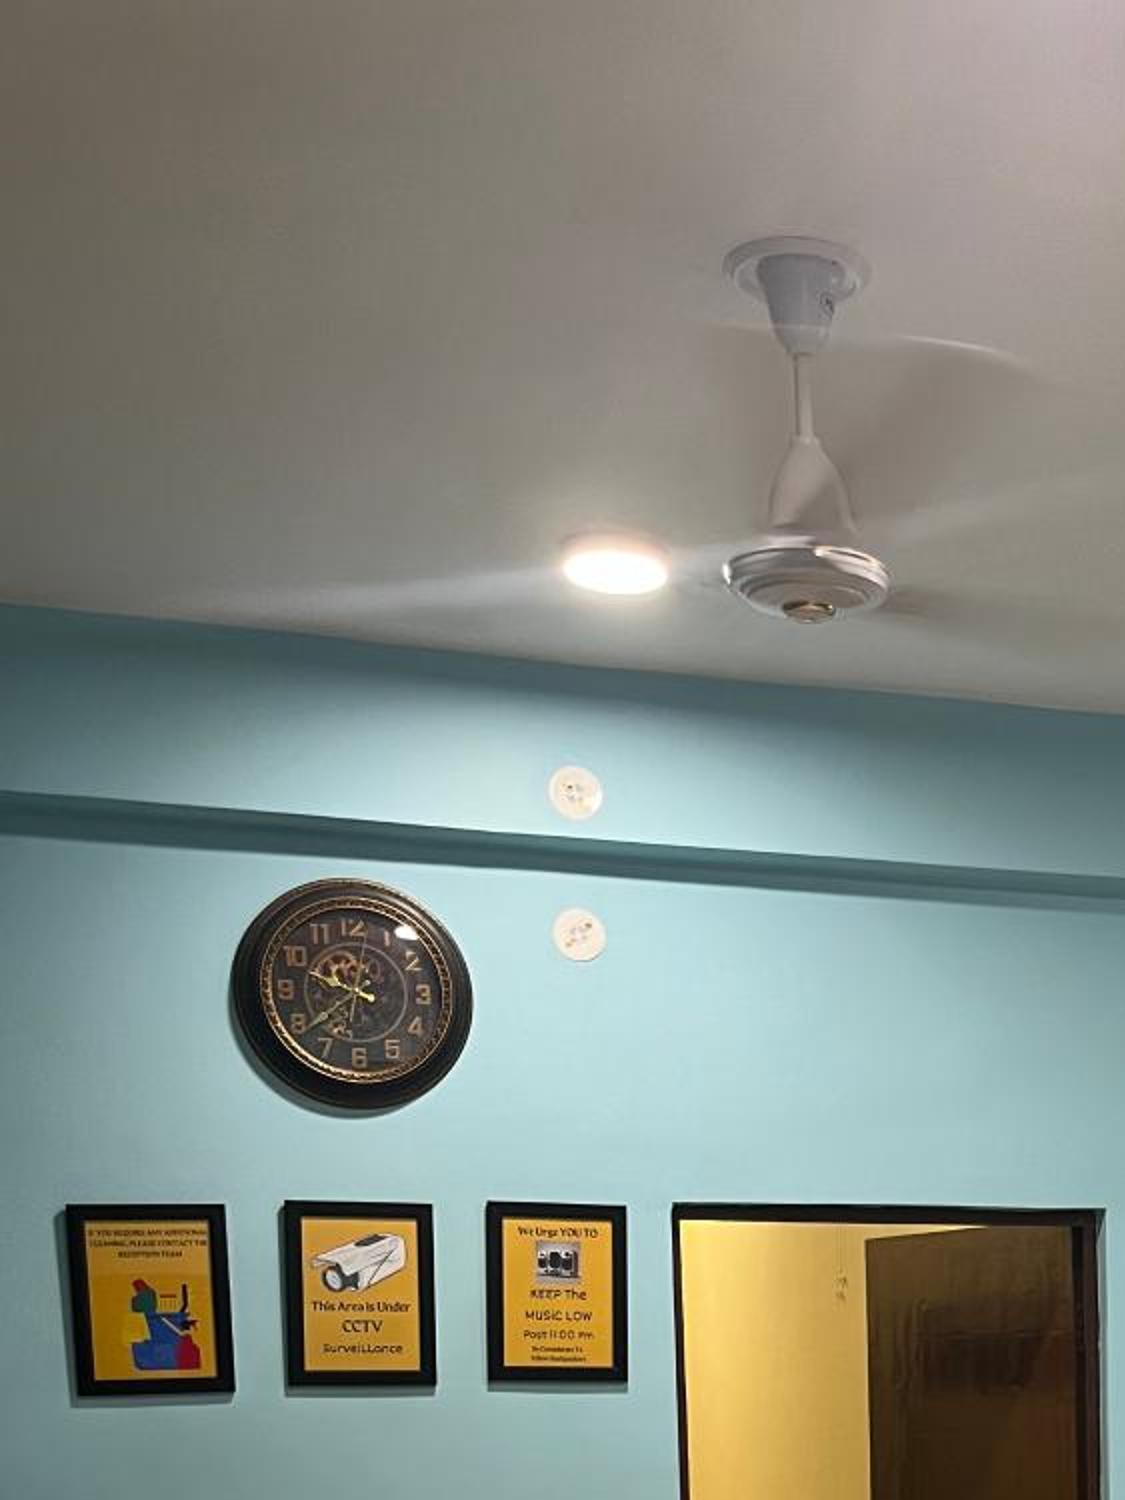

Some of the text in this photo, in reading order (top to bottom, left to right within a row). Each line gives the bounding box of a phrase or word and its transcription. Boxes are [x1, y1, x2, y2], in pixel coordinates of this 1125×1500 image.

[311, 923, 329, 944] 11
[341, 920, 367, 937] 12
[382, 931, 390, 946] 1
[283, 945, 307, 967] 10
[404, 951, 423, 972] 2
[277, 979, 294, 1000] 9
[415, 984, 431, 1005] 3
[288, 1013, 307, 1035] 8
[407, 1016, 424, 1036] 4
[318, 1037, 333, 1058] 7
[384, 1039, 401, 1059] 5
[352, 1047, 367, 1069] 6
[535, 1226, 558, 1238] Urge
[560, 1227, 583, 1239] YOU
[585, 1228, 599, 1239] TO
[530, 1288, 587, 1301] KEEP The
[313, 1301, 411, 1313] This Area is Under
[565, 1311, 593, 1322] LOW
[342, 1319, 383, 1333] CCTV
